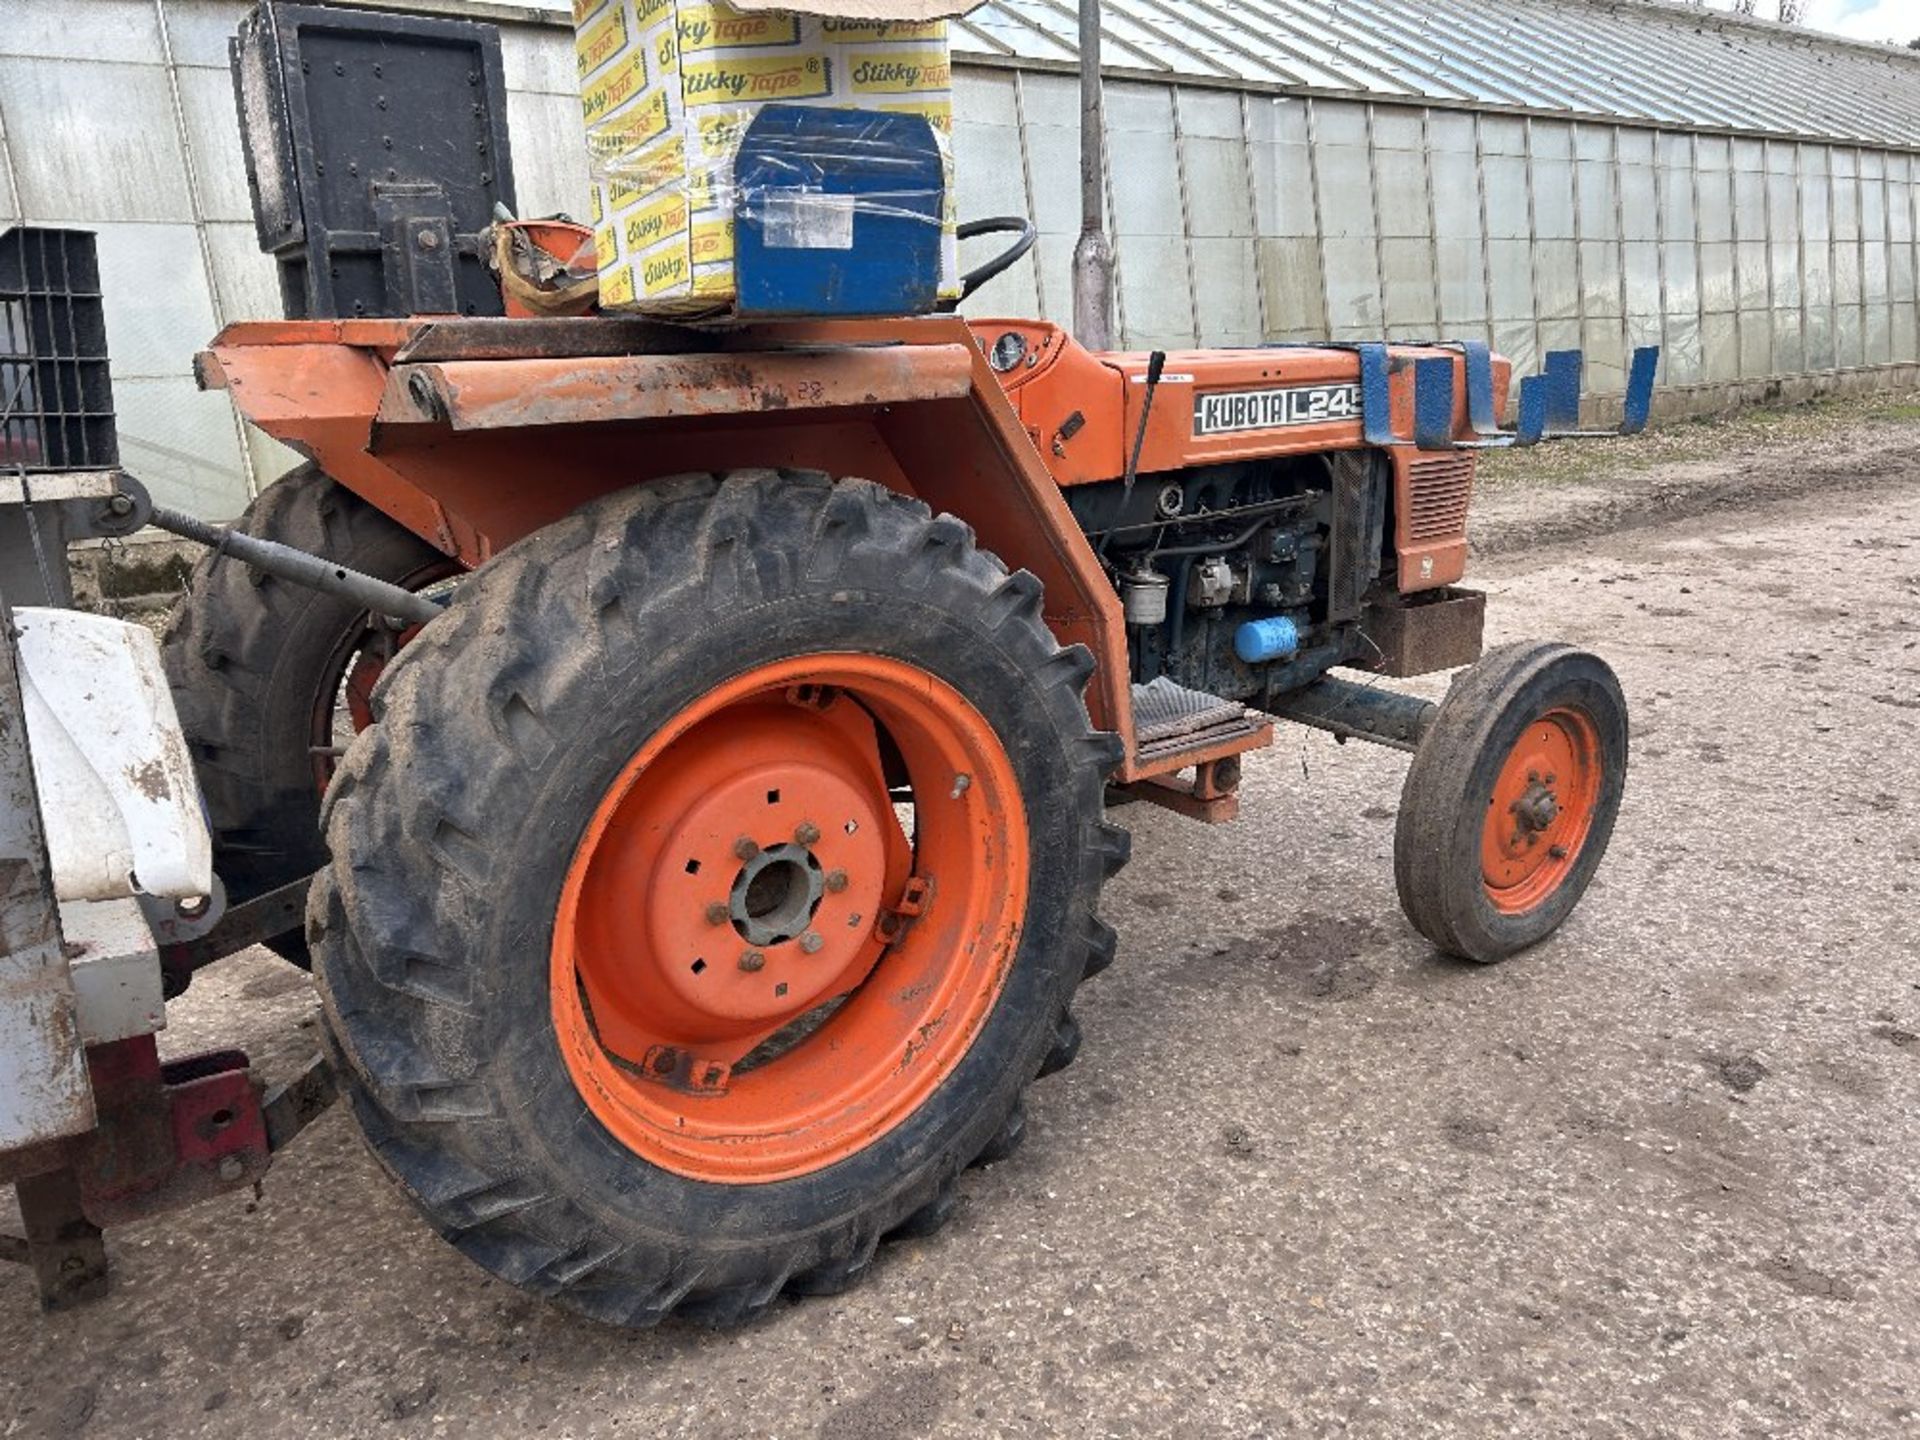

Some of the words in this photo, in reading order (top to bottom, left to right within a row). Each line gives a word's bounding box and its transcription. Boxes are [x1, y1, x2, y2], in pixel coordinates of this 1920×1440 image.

[711, 15, 770, 41] Tape
[747, 66, 803, 95] Tape
[853, 61, 920, 87] Stikky
[920, 63, 950, 84] Tap
[1205, 393, 1284, 429] KUBOTA
